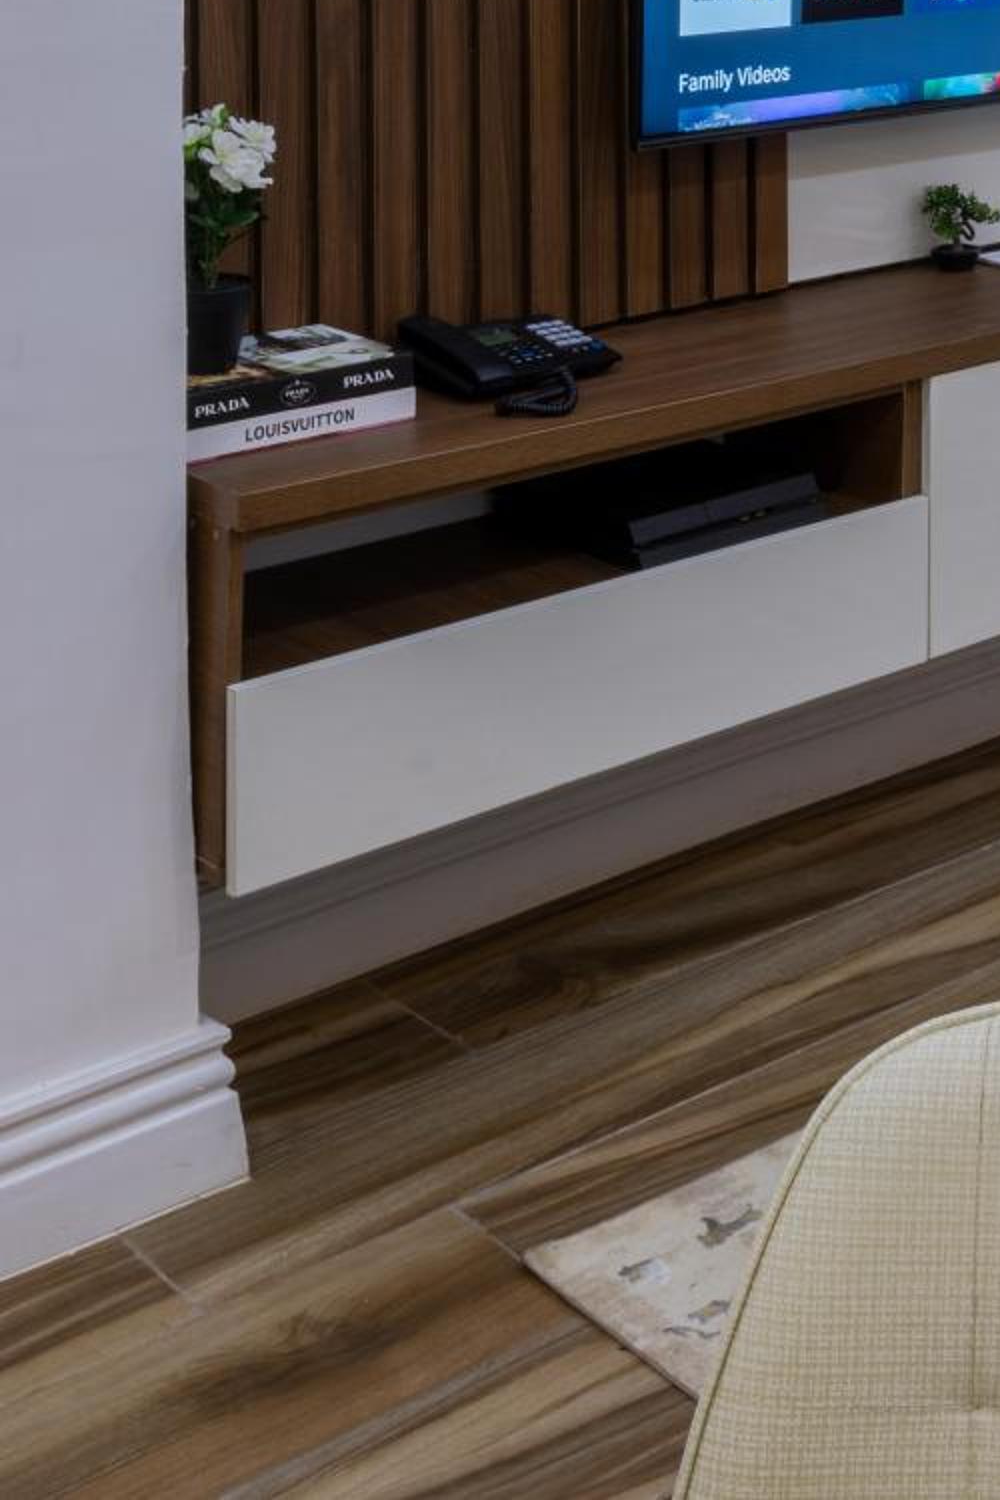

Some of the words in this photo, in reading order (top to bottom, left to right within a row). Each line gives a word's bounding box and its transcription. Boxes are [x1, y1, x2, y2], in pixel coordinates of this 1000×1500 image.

[679, 67, 733, 93] Family
[737, 65, 791, 86] Videos
[194, 396, 250, 419] PRADA
[343, 369, 395, 388] PRADA
[245, 407, 355, 442] LOUISVUITTON
